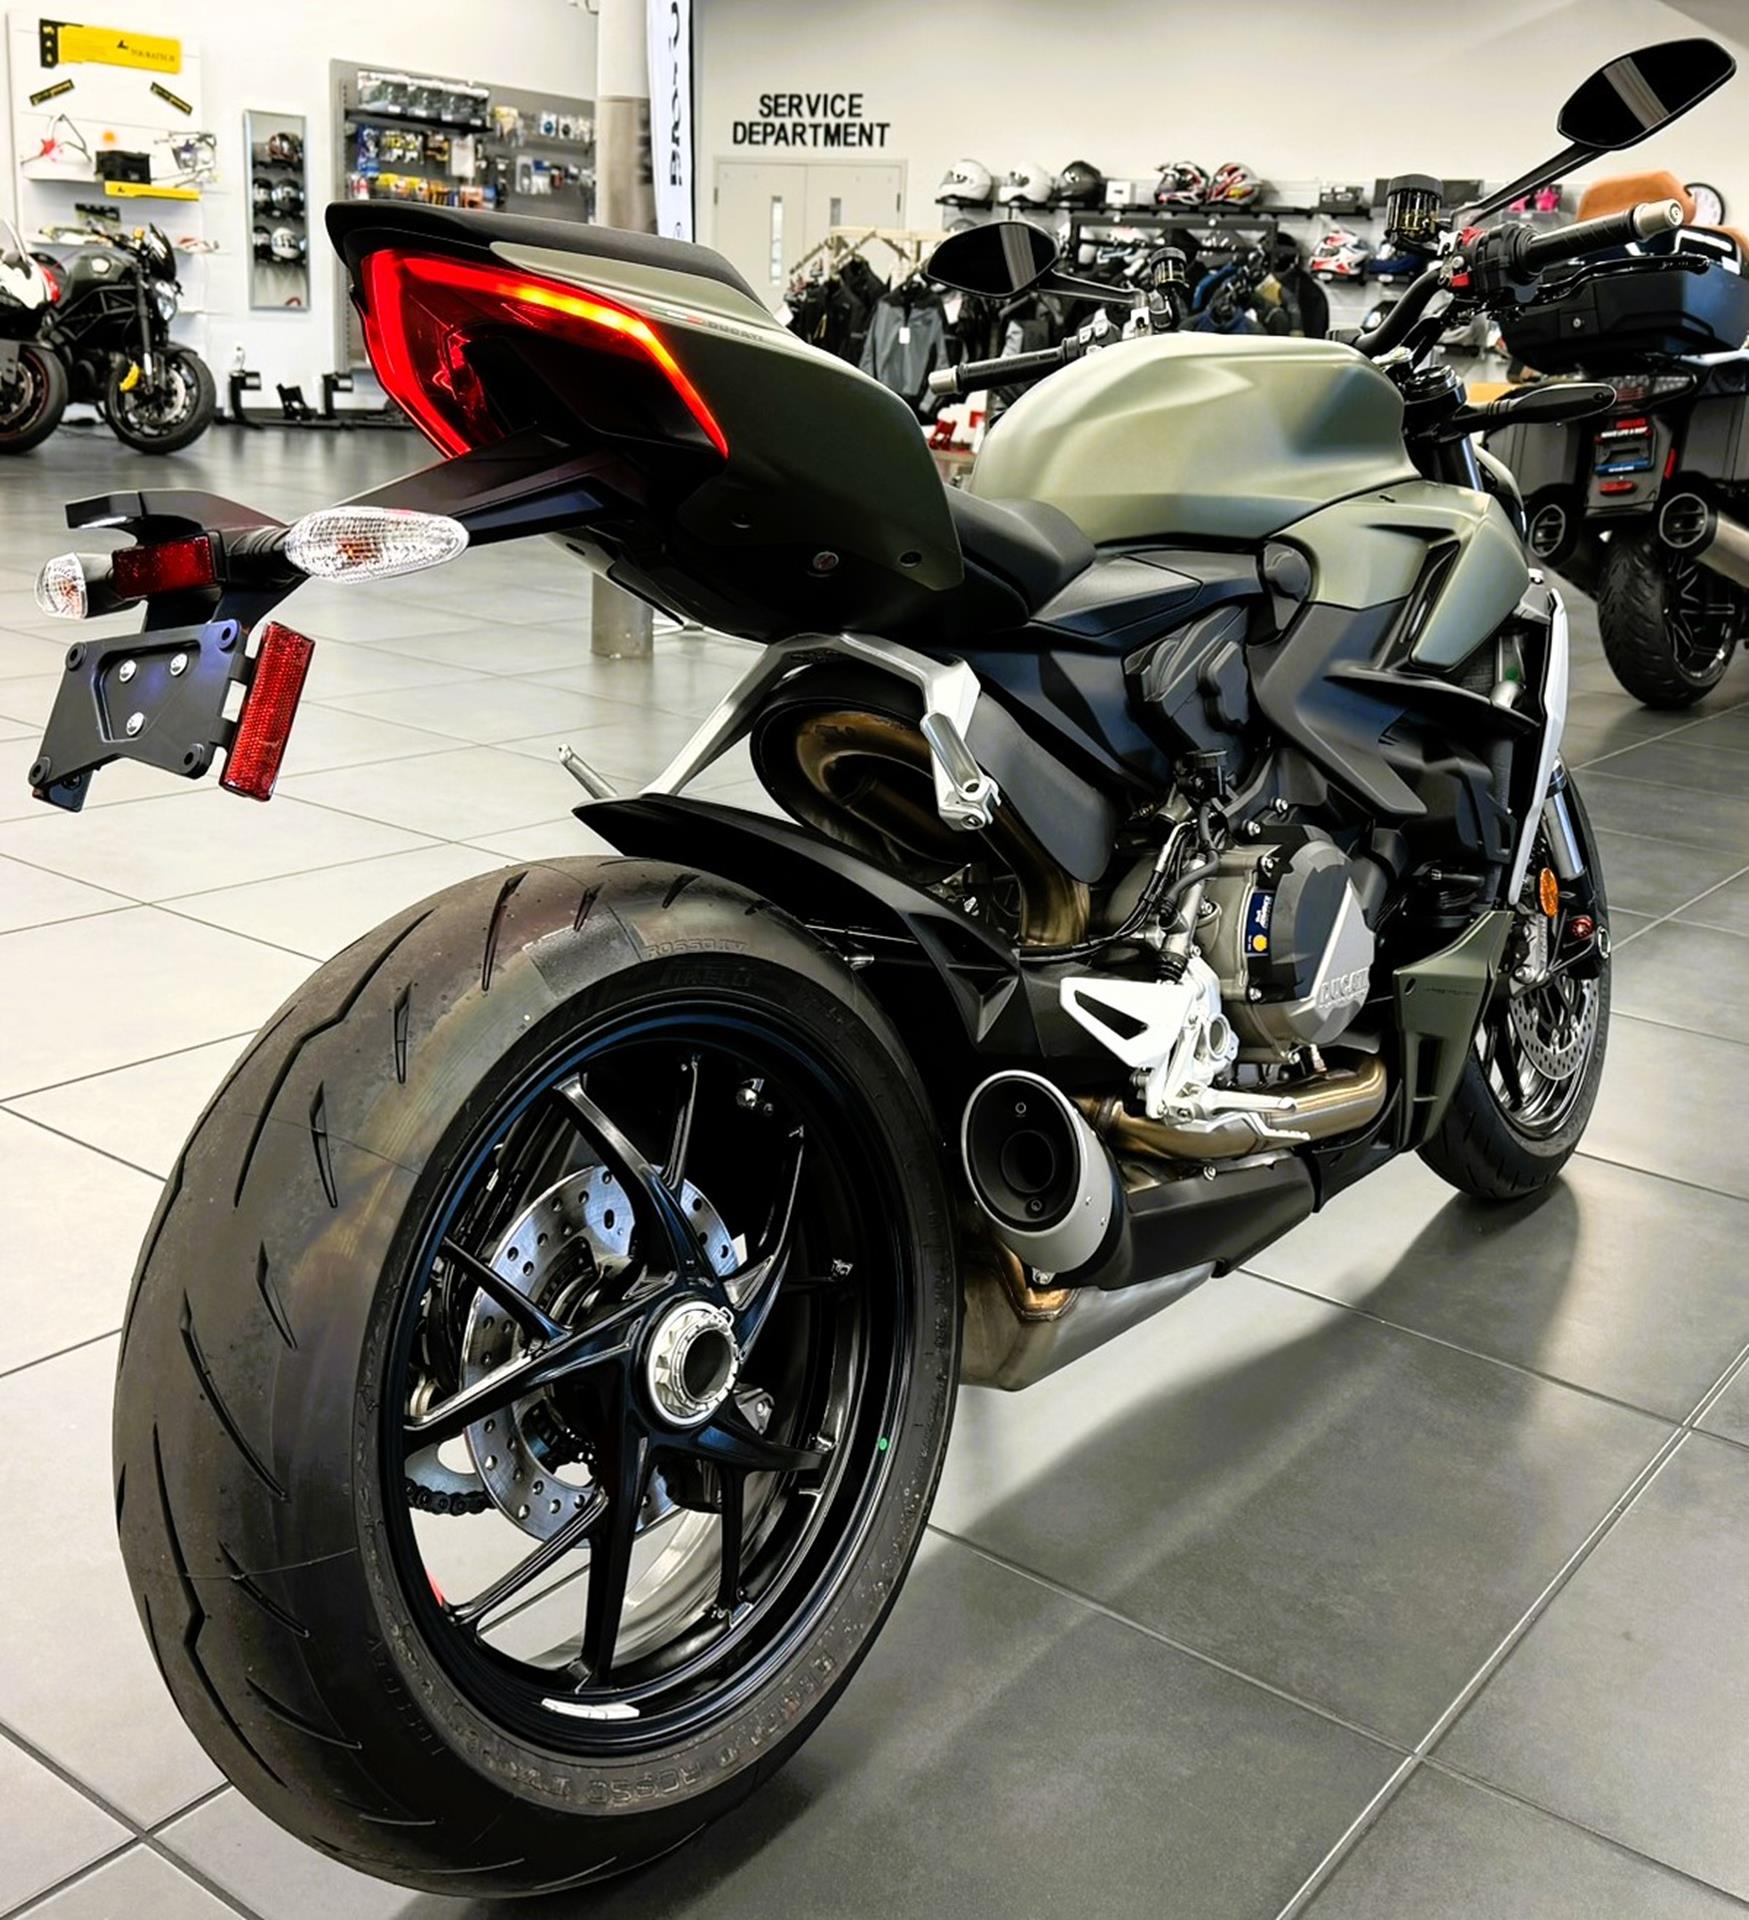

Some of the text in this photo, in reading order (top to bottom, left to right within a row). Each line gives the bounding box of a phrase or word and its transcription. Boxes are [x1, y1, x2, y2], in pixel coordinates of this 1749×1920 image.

[759, 93, 864, 118] SERVICE
[732, 121, 891, 148] DEPARTMENT
[646, 938, 716, 957] ROSSO
